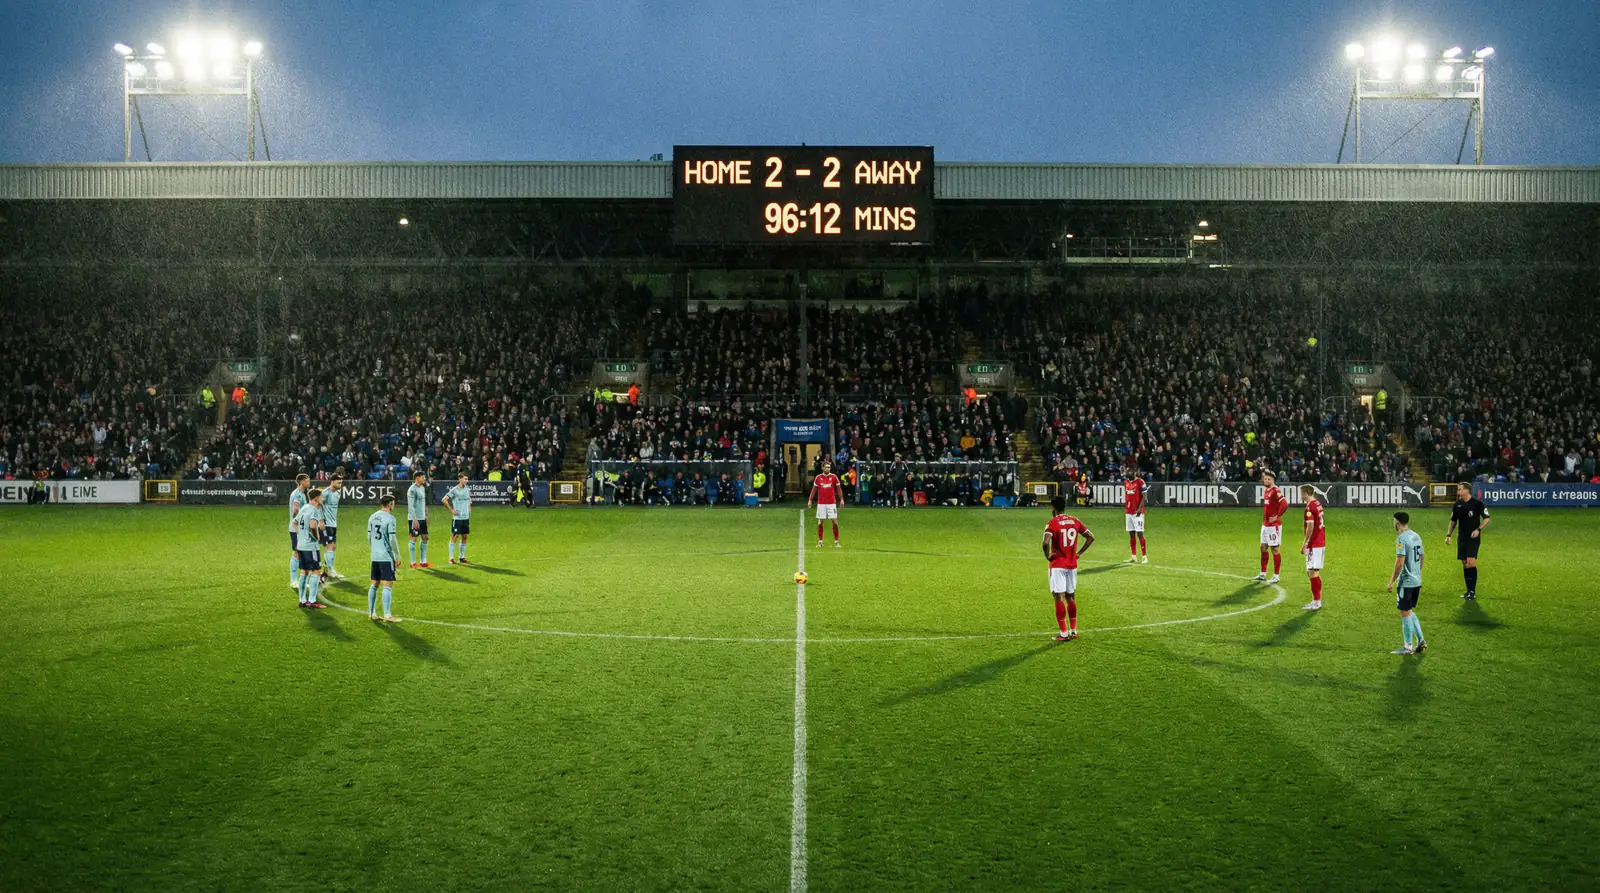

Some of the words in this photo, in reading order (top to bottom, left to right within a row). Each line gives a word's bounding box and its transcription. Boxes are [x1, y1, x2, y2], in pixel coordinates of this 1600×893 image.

[684, 160, 752, 185] HOME
[765, 156, 783, 188] 2
[795, 168, 811, 177] -
[823, 156, 841, 188] 2
[854, 160, 922, 185] AWAY
[765, 202, 841, 234] 96:12
[854, 206, 916, 231] MINS
[1164, 485, 1219, 504] PUMA
[1346, 485, 1403, 504] PUMA
[374, 524, 382, 541] 3
[1060, 527, 1077, 547] 19
